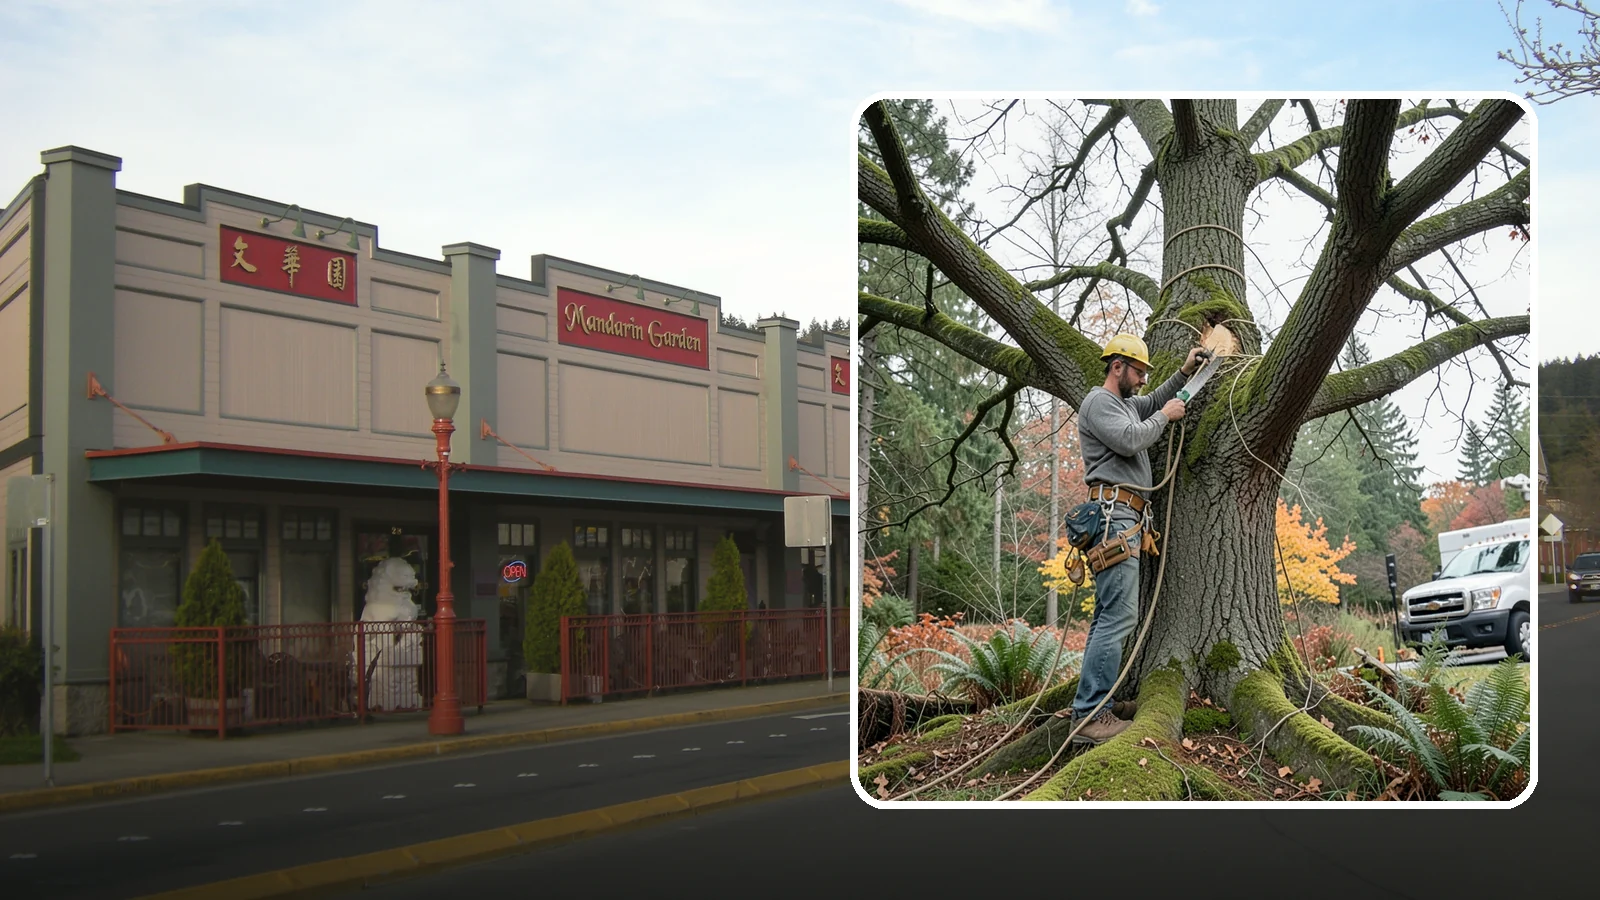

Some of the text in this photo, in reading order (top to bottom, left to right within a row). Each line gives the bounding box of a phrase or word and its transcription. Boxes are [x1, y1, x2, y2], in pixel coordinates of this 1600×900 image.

[230, 235, 346, 290] 文華園
[564, 302, 702, 352] Mandarin Garden
[834, 362, 847, 386] 文
[503, 565, 527, 578] OPEN
